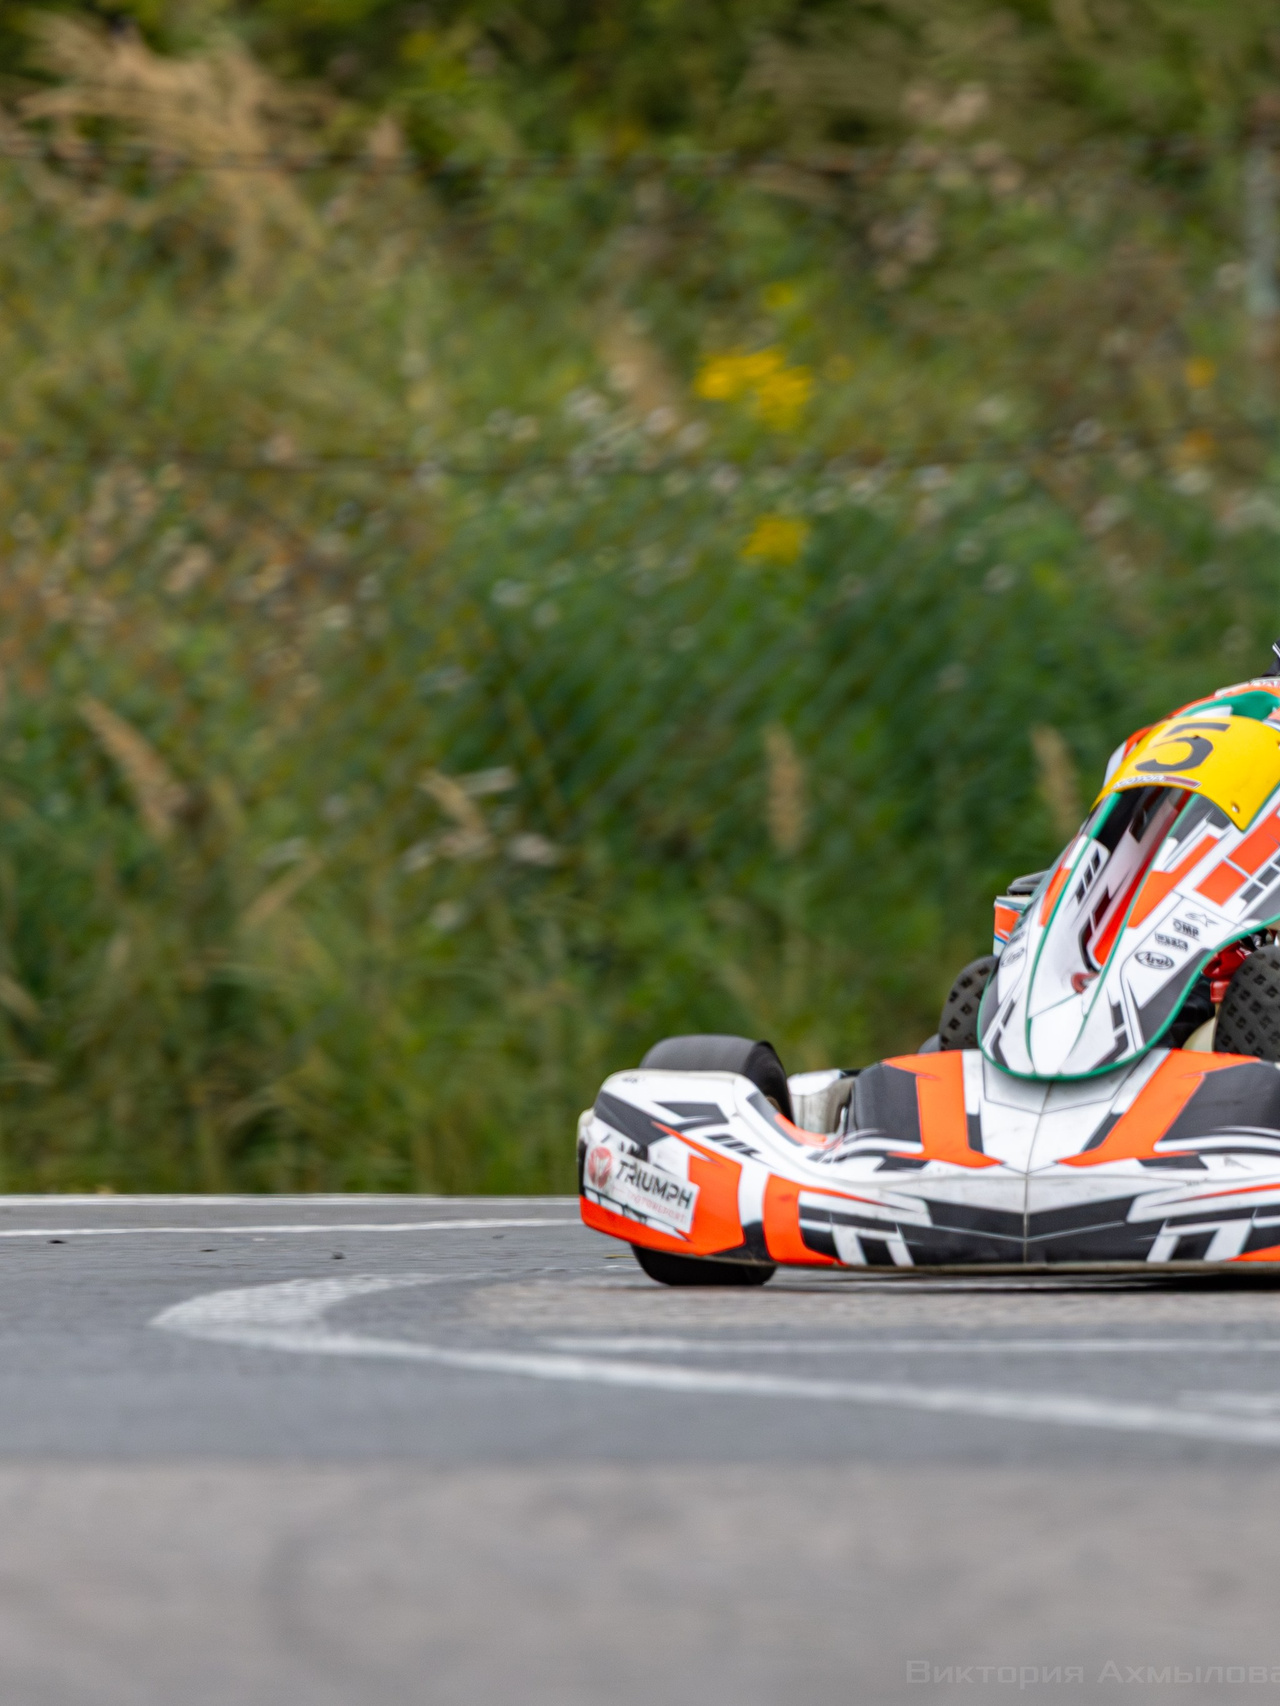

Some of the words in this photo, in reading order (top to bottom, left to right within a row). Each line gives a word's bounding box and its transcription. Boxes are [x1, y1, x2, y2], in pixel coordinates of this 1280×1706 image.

[1135, 722, 1231, 773] 5
[1172, 919, 1200, 938] OMP
[615, 1160, 693, 1210] TRIUMPH
